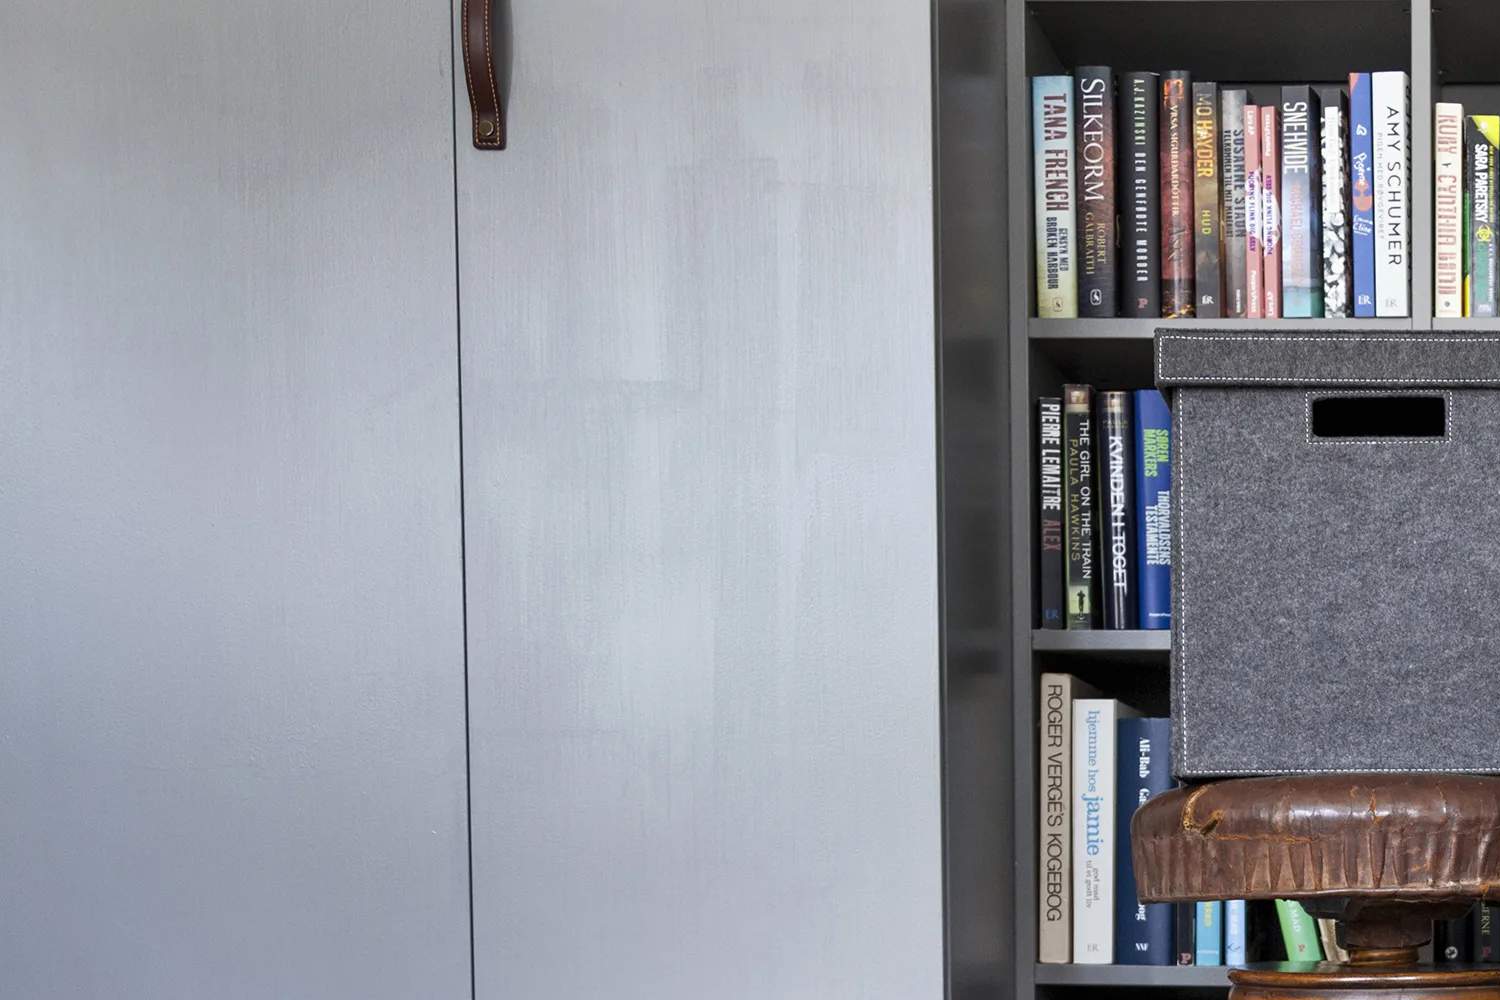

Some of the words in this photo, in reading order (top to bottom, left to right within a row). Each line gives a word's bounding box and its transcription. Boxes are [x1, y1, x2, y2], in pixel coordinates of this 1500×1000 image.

[1044, 93, 1067, 141] TANA
[1197, 93, 1211, 116] MO
[1386, 106, 1400, 152] AMY
[1081, 78, 1105, 200] SILKEORM
[1197, 120, 1213, 177] HAYDER
[1284, 102, 1307, 174] SNEHVIDE
[1475, 144, 1488, 170] SARA
[1045, 149, 1069, 211] FRENCH
[1475, 172, 1488, 223] PARETSKY
[1201, 210, 1210, 234] HUD
[1388, 161, 1401, 265] SCHUMER
[1041, 404, 1060, 444] PIERRE
[1080, 420, 1089, 445] THE
[1042, 449, 1060, 510] LEMAITRE
[1070, 440, 1079, 485] PAULA
[1080, 450, 1090, 479] GIRL
[1081, 486, 1090, 506] ON
[1043, 520, 1061, 551] ALEX
[1071, 494, 1080, 561] HAWKINS
[1081, 512, 1091, 535] THE
[1146, 505, 1158, 565] TESTAMENTE
[1082, 541, 1092, 579] TRAIN
[1048, 685, 1062, 747] ROGER
[1086, 710, 1100, 766] hjemme
[1047, 752, 1066, 827] VERGÉ'S
[1088, 769, 1100, 792] hos
[1081, 794, 1104, 856] jamie
[1047, 833, 1062, 921] KOGEBOG
